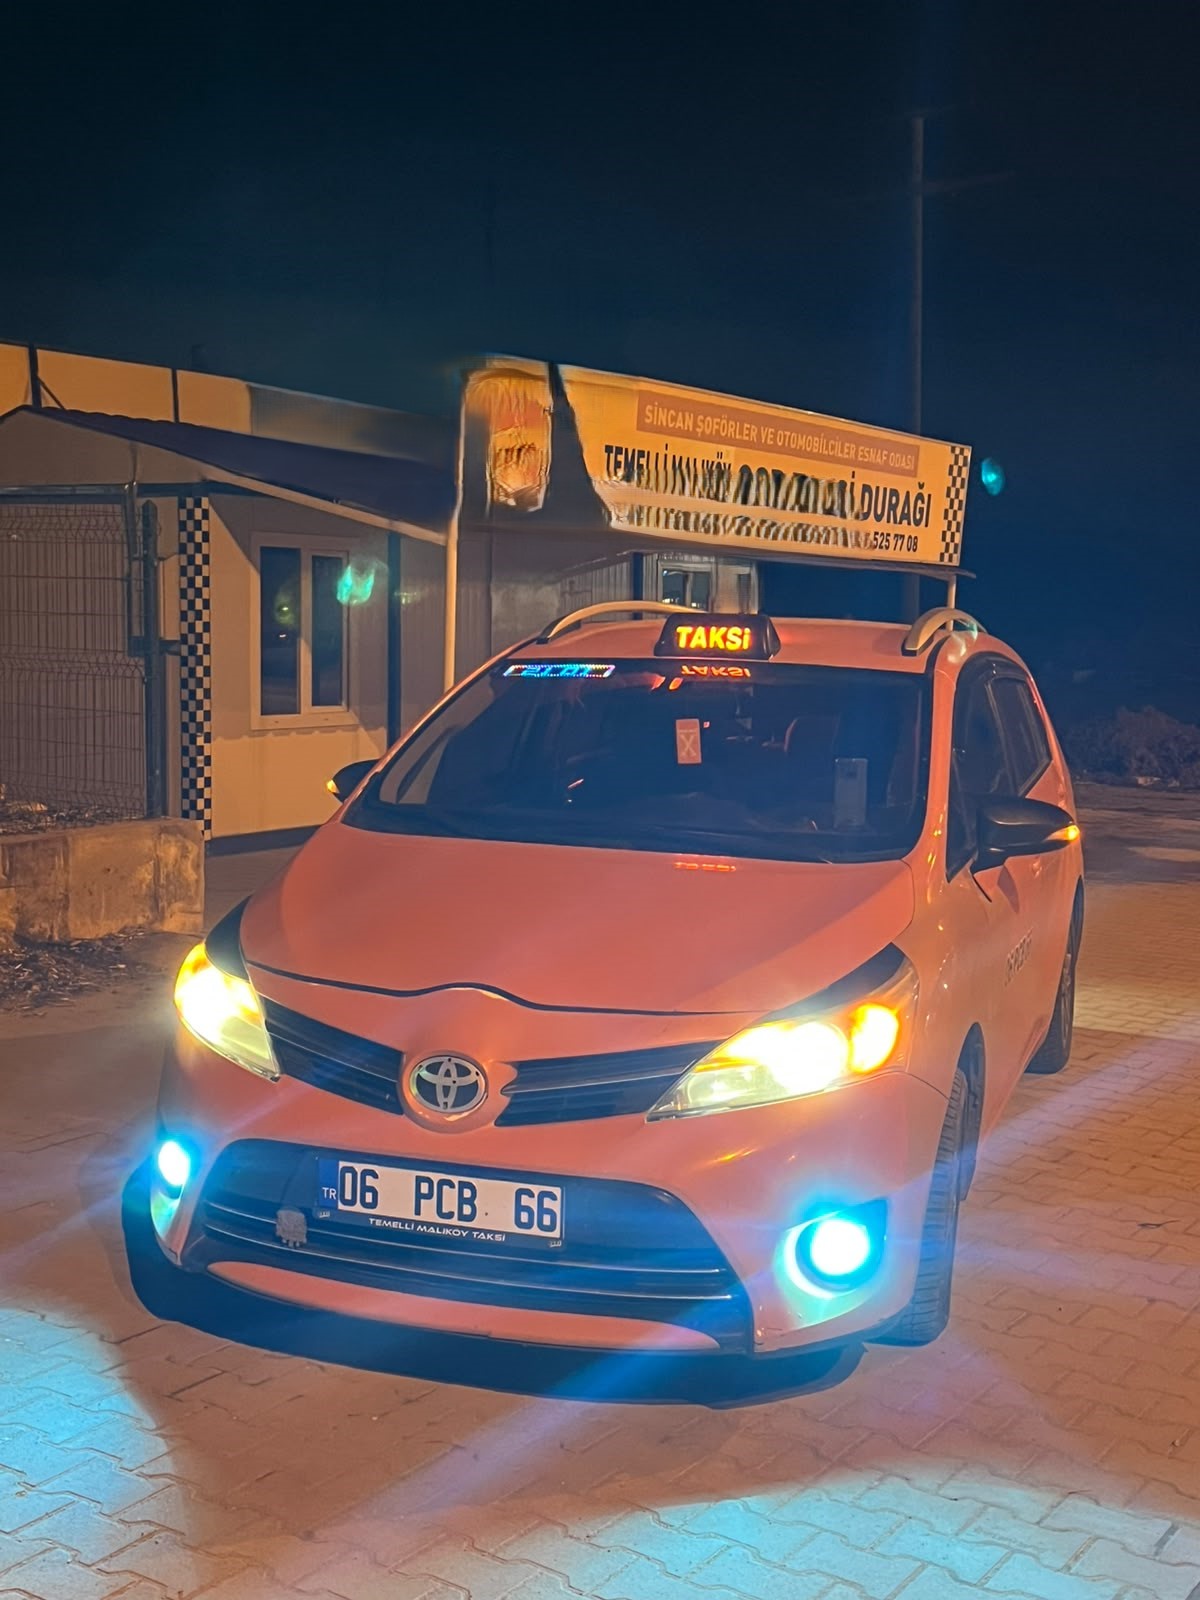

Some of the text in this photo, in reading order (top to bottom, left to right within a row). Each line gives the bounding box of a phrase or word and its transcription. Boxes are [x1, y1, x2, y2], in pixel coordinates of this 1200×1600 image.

[644, 402, 915, 470] SİNCAN ŞOFÖRLER VE OTOMOBİLCİLER ESNAF ODASI
[860, 482, 931, 527] DURAĞI
[873, 531, 918, 552] 525 77 08
[322, 1187, 337, 1200] TR
[340, 1166, 557, 1233] 06 PCB 66
